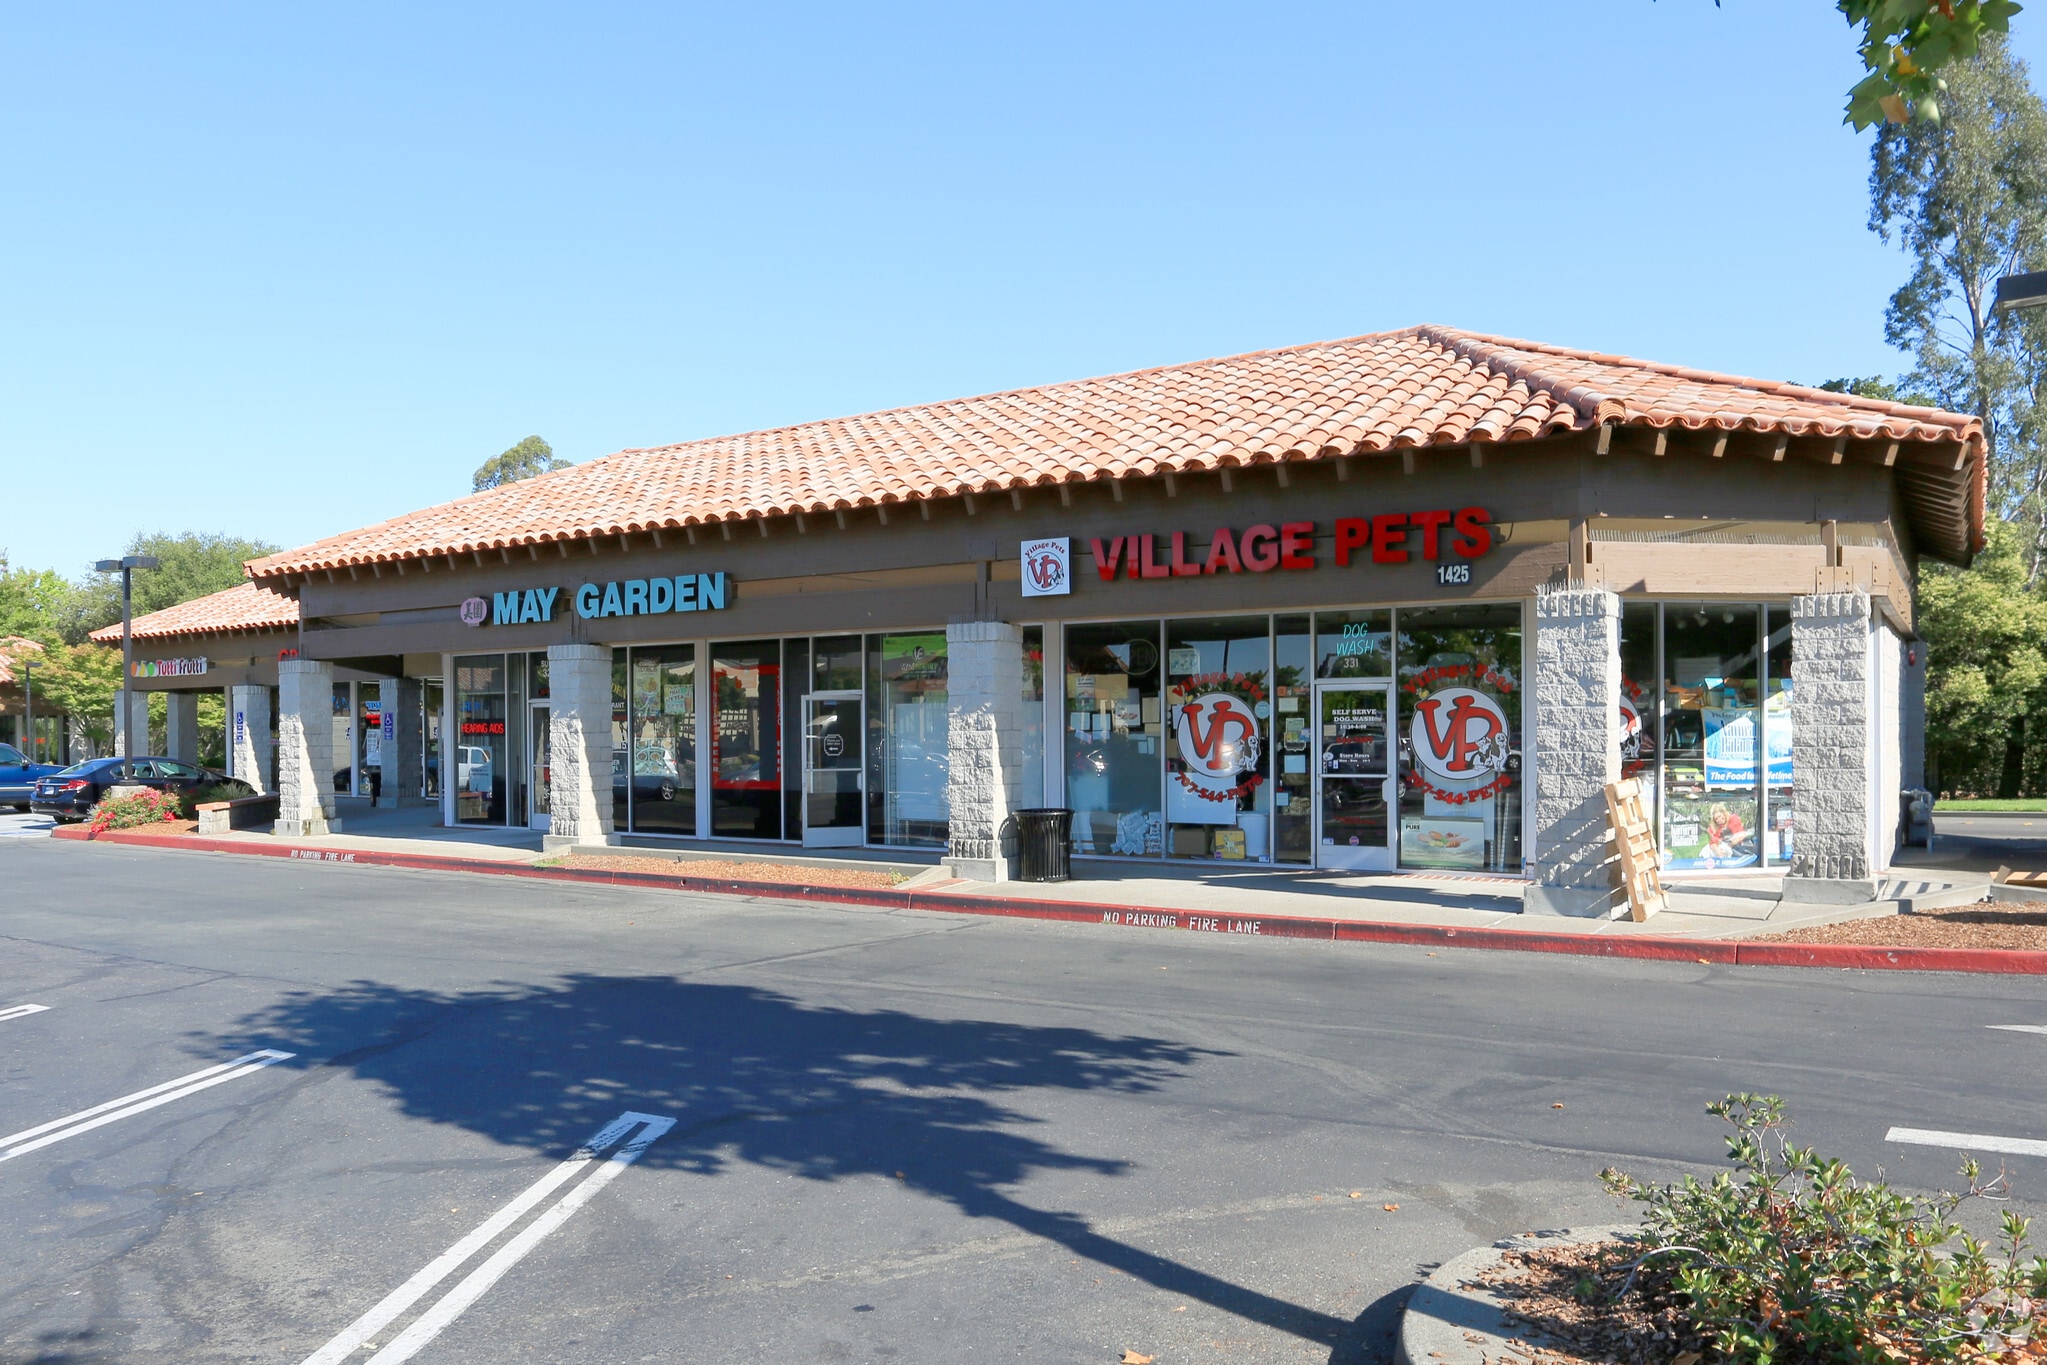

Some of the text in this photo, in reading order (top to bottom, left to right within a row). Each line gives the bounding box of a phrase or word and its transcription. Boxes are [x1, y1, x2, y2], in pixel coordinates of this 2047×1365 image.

[1025, 541, 1066, 558] Village Pets
[1090, 506, 1491, 581] VILLAGE PETS
[1027, 555, 1061, 588] VP
[1438, 565, 1469, 584] 1425
[493, 571, 726, 625] MAY GARDEN
[1343, 622, 1369, 639] DOG
[1336, 639, 1375, 656] WASH
[156, 656, 203, 676] Tutti Frutti
[1343, 658, 1359, 668] 331
[1172, 672, 1265, 700] Village Pets
[1404, 663, 1514, 694] Village Pets
[461, 722, 504, 734] HEARING AIDS
[1415, 695, 1503, 772] VP
[1175, 770, 1264, 802] 707-544-PETS
[1711, 771, 1725, 780] The
[1726, 771, 1746, 780] Food
[1405, 769, 1513, 805] 707-544-PETS
[291, 850, 356, 862] NO PARKING FIRE LANE
[1103, 911, 1262, 935] NO PARKING FIRE LANE
